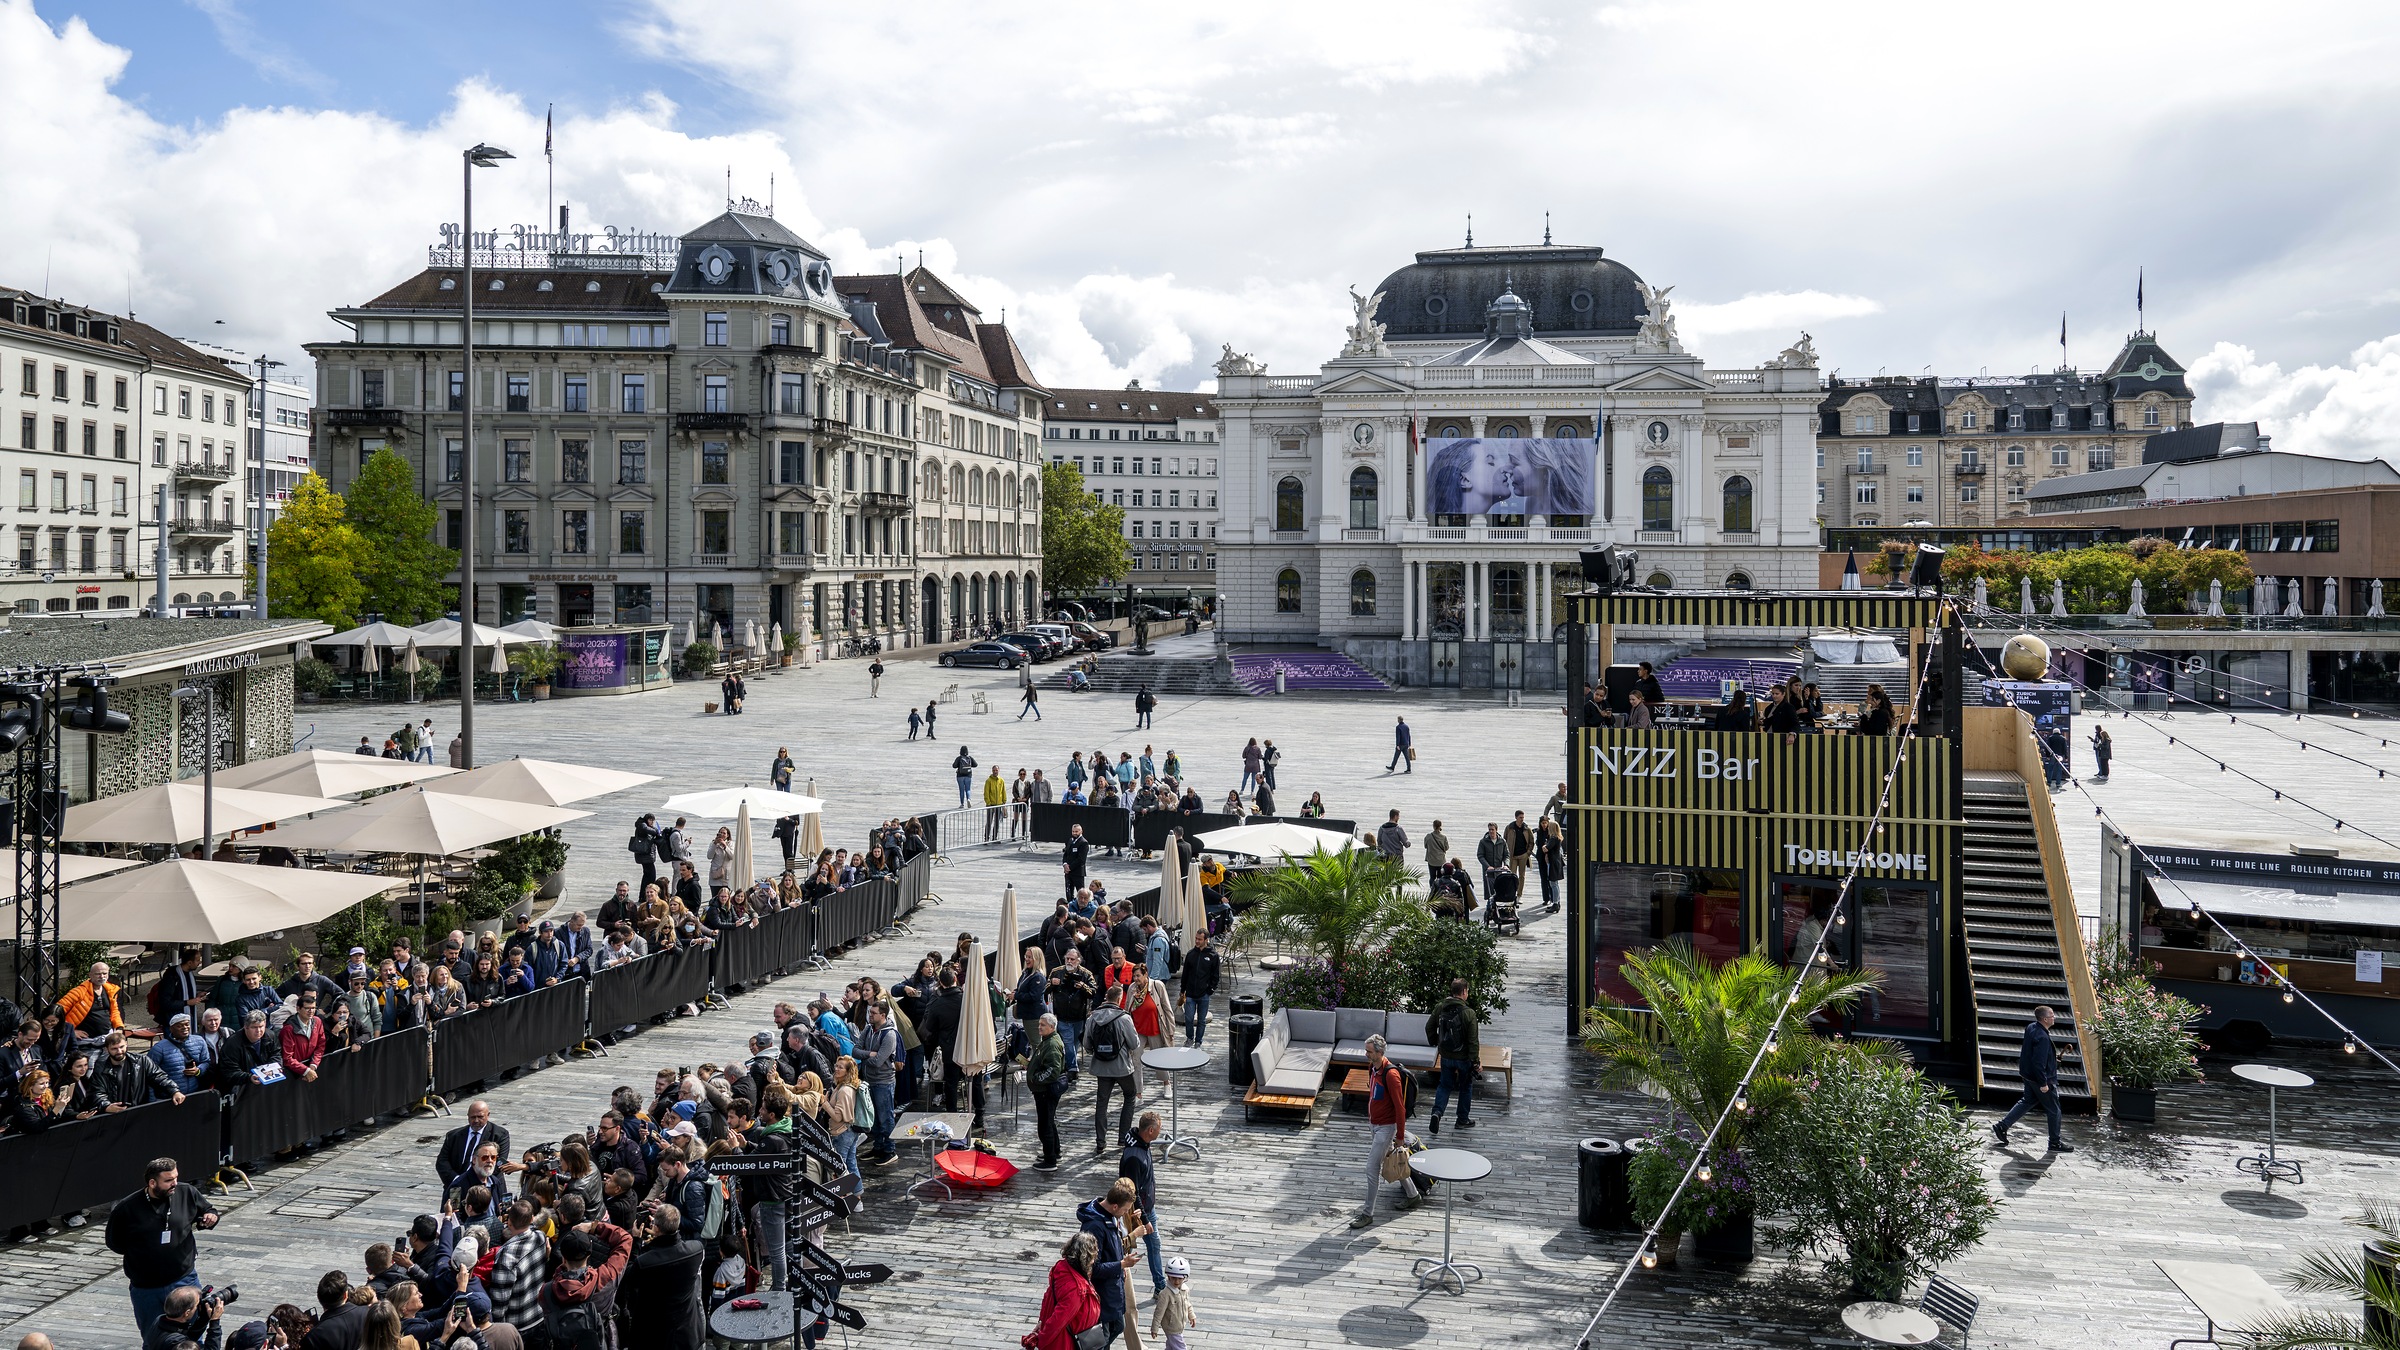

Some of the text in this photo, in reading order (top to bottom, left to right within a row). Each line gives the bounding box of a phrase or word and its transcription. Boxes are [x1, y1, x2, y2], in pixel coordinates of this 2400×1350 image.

[438, 223, 498, 250] Nue
[1149, 542, 1175, 552] Zürcher
[1177, 542, 1203, 554] Zeitung
[587, 639, 617, 648] 2025/26
[185, 651, 260, 676] PARKHAUS OPÉRA
[568, 667, 613, 675] OPERNHAUS
[576, 674, 605, 682] ZÜRICH
[1589, 745, 1760, 781] NZZ Bar
[1784, 844, 1927, 871] TOBLERONE
[2175, 856, 2201, 866] GRILL
[2211, 859, 2231, 868] FINE
[2234, 861, 2256, 870] DINE
[2260, 863, 2280, 872] LINE
[2291, 864, 2329, 875] ROLLING
[2333, 867, 2372, 878] KITCHEN
[709, 1160, 793, 1171] Arthouse Le Pari
[812, 1187, 835, 1207] Lounges
[806, 1210, 835, 1227] NZZ Ba
[845, 1270, 872, 1279] rucks
[837, 1308, 851, 1321] WC
